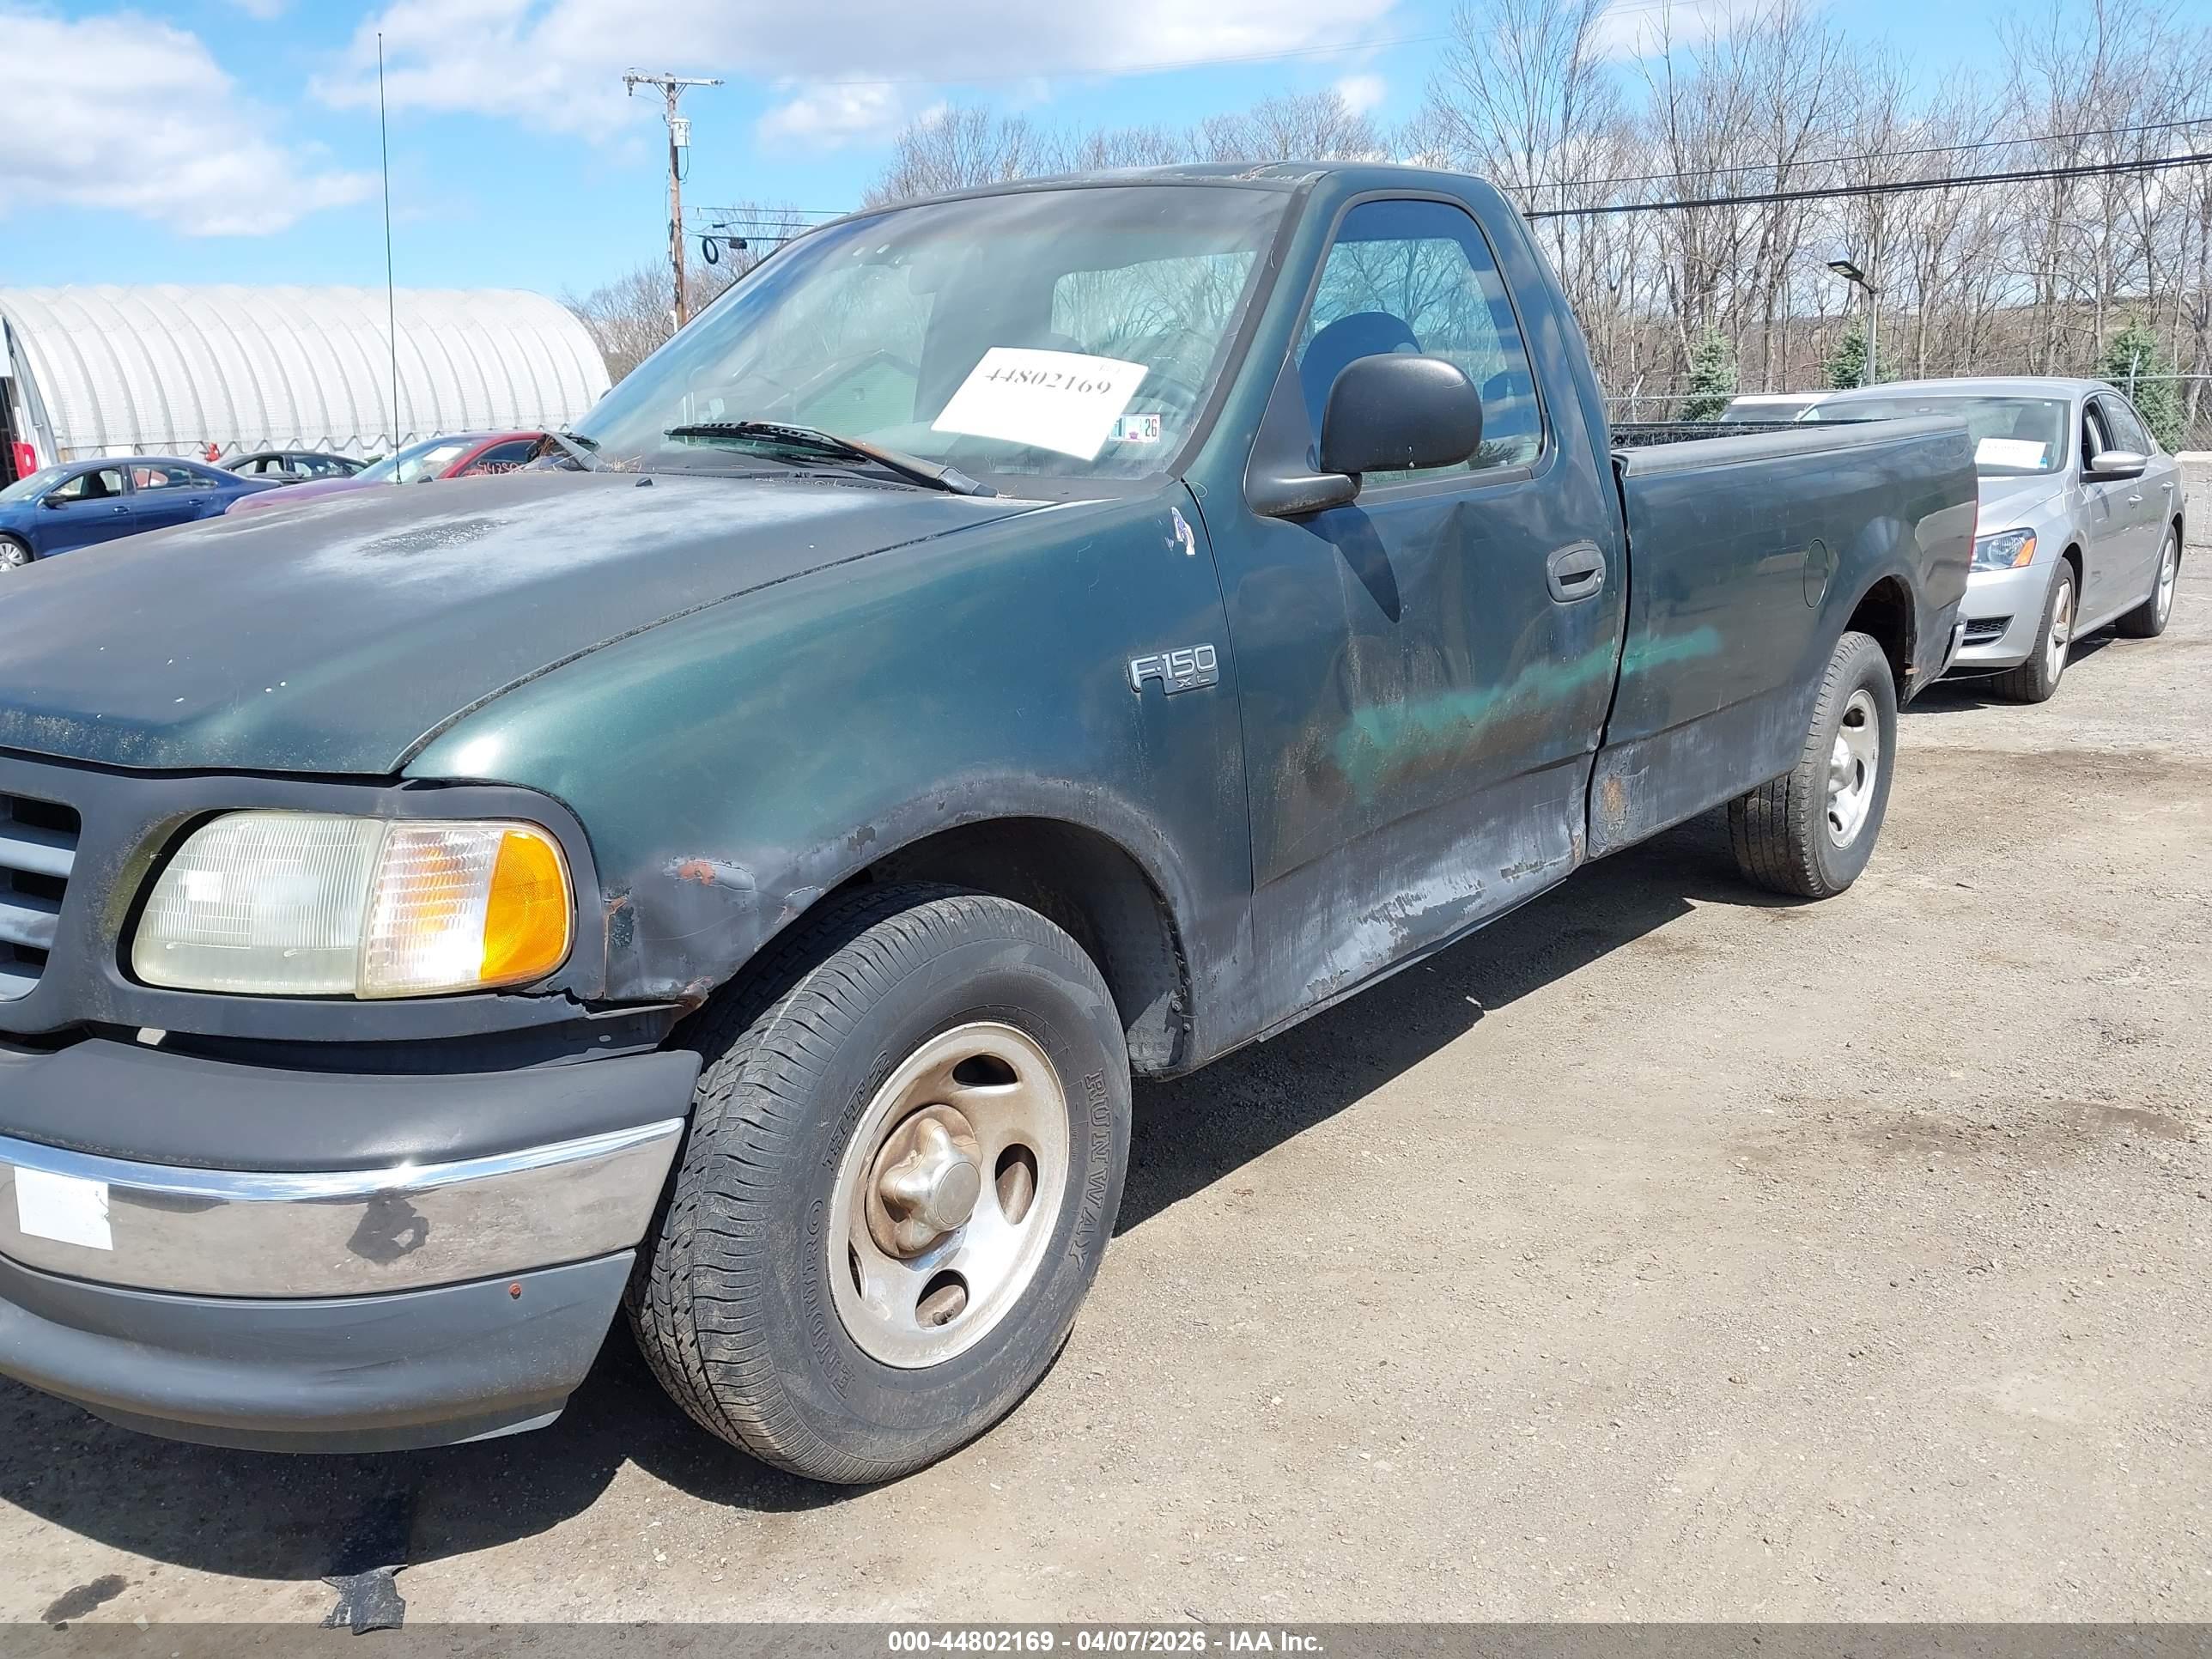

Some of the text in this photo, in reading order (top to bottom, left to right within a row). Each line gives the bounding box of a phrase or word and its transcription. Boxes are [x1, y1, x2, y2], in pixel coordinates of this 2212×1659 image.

[985, 368, 1112, 394] 44802169
[1145, 418, 1158, 437] 26
[1130, 645, 1218, 689] F-150
[1176, 675, 1210, 689] XL
[1068, 1069, 1111, 1272] RUNWAY
[802, 1199, 856, 1400] ENDURO
